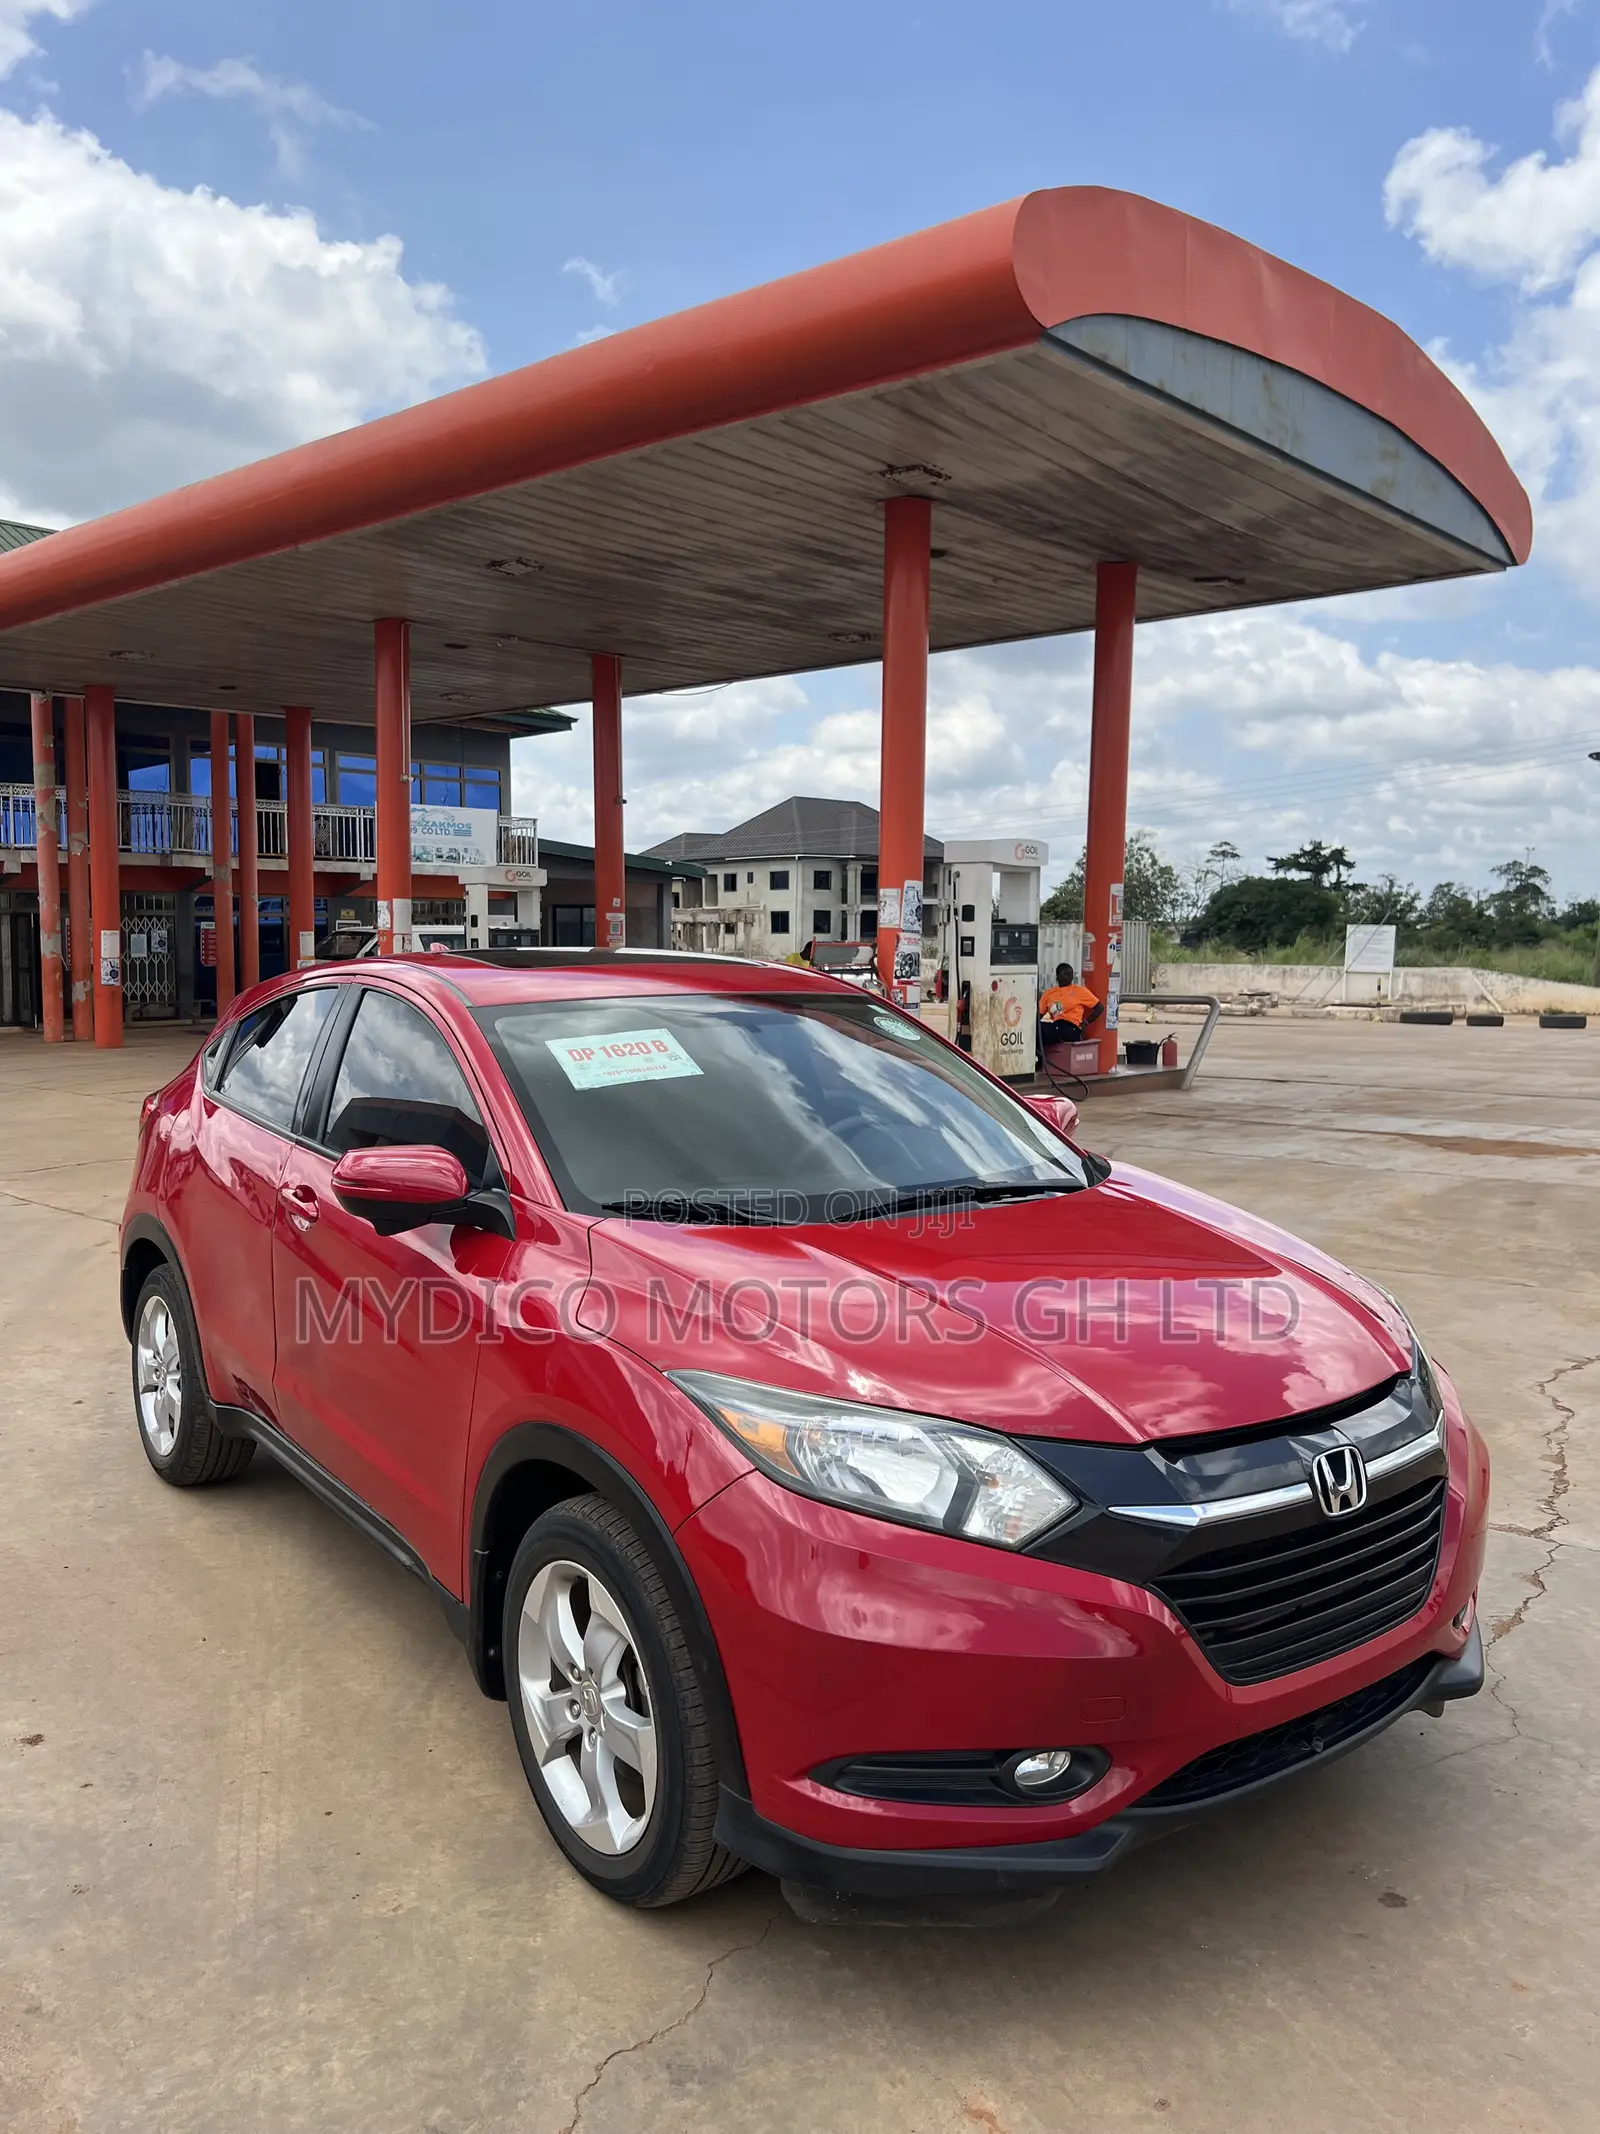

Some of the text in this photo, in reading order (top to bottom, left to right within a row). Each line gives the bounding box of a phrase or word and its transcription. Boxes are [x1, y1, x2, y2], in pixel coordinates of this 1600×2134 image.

[1000, 1032, 1024, 1046] GOIL
[599, 1040, 653, 1059] 1620
[651, 1039, 669, 1053] B
